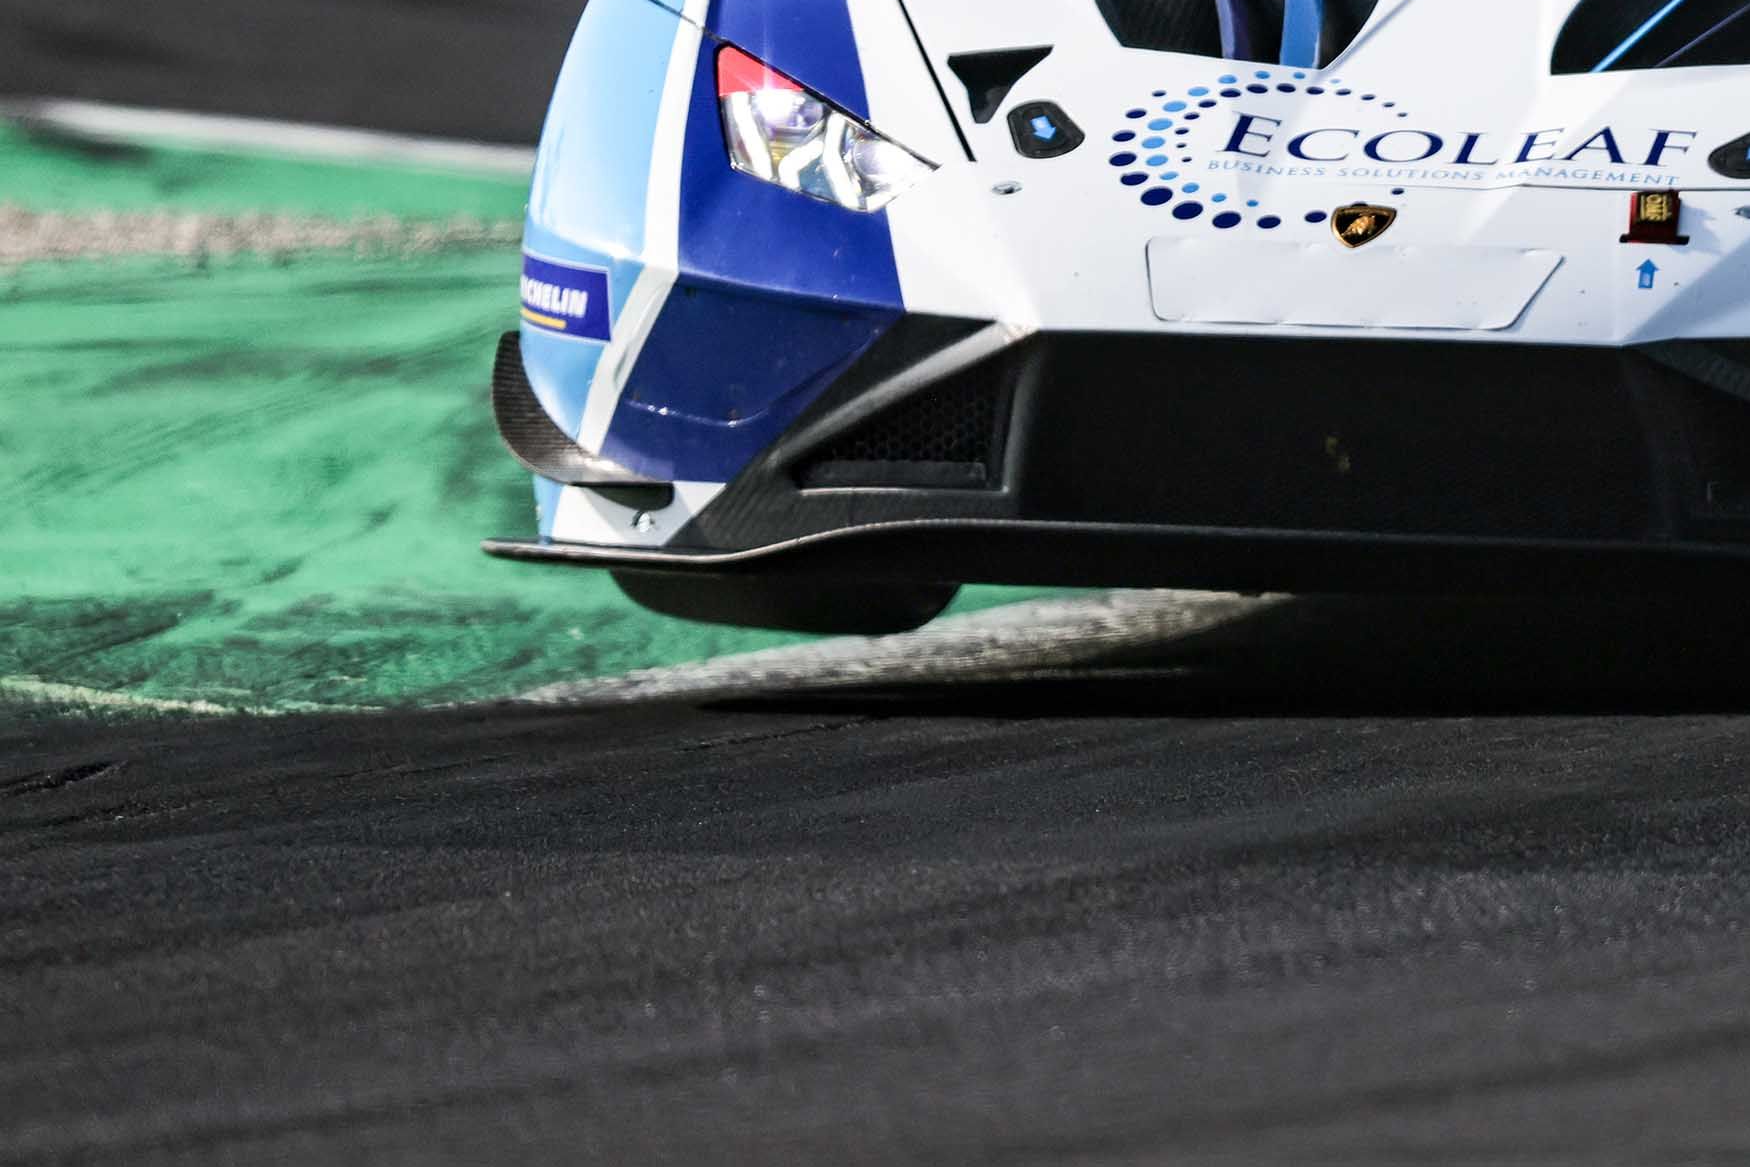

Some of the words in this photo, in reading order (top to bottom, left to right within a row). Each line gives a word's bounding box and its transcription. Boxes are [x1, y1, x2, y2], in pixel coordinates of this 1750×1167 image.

[1216, 111, 1697, 167] ECOLEAF
[1207, 159, 1326, 177] BUSINESS
[1336, 166, 1484, 181] SOLUTIONS
[1496, 166, 1681, 186] MANAGEMENT
